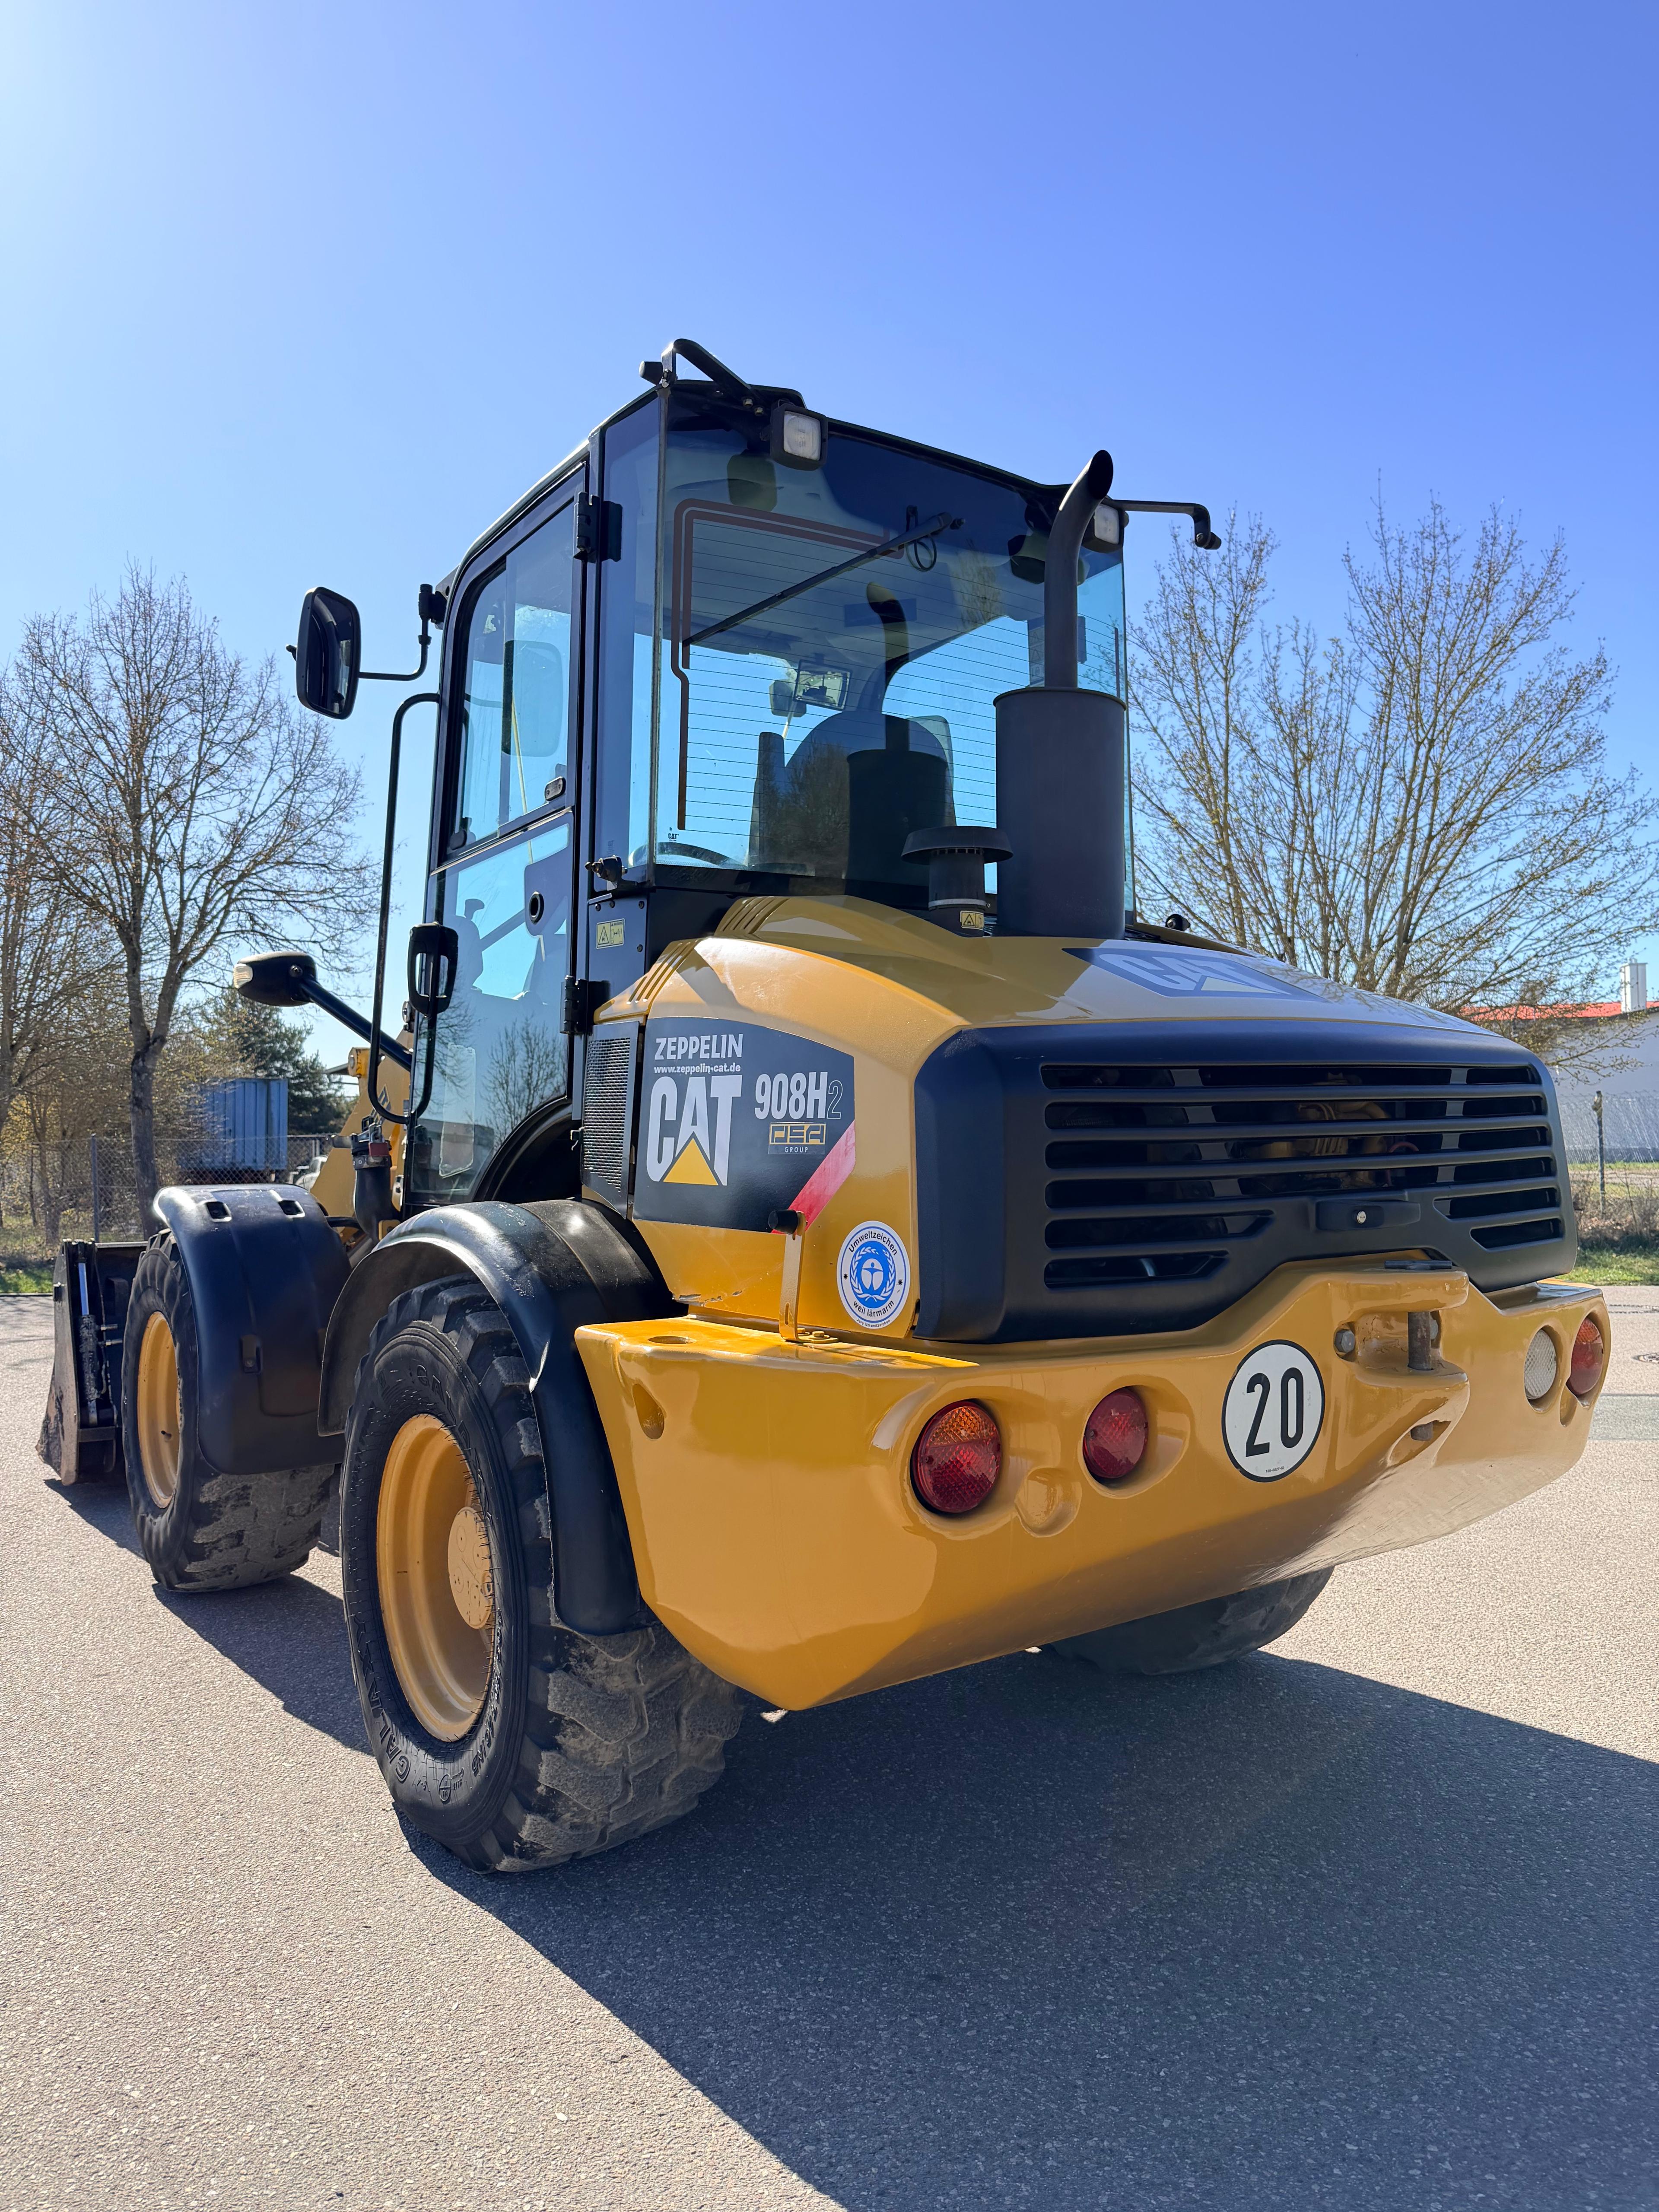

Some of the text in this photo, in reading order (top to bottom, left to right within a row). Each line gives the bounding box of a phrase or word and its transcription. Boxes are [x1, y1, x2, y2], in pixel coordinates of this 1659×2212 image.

[1099, 953, 1291, 994] CAT
[655, 1033, 743, 1060] ZEPPELIN
[654, 1062, 741, 1075] www.zeppelin-cat.de
[647, 1075, 742, 1186] CAT
[849, 1231, 897, 1255] Umweltzeichen
[854, 1300, 894, 1317] weil lärmarm
[1246, 1367, 1304, 1457] 20
[352, 1614, 411, 1783] GALAXY
